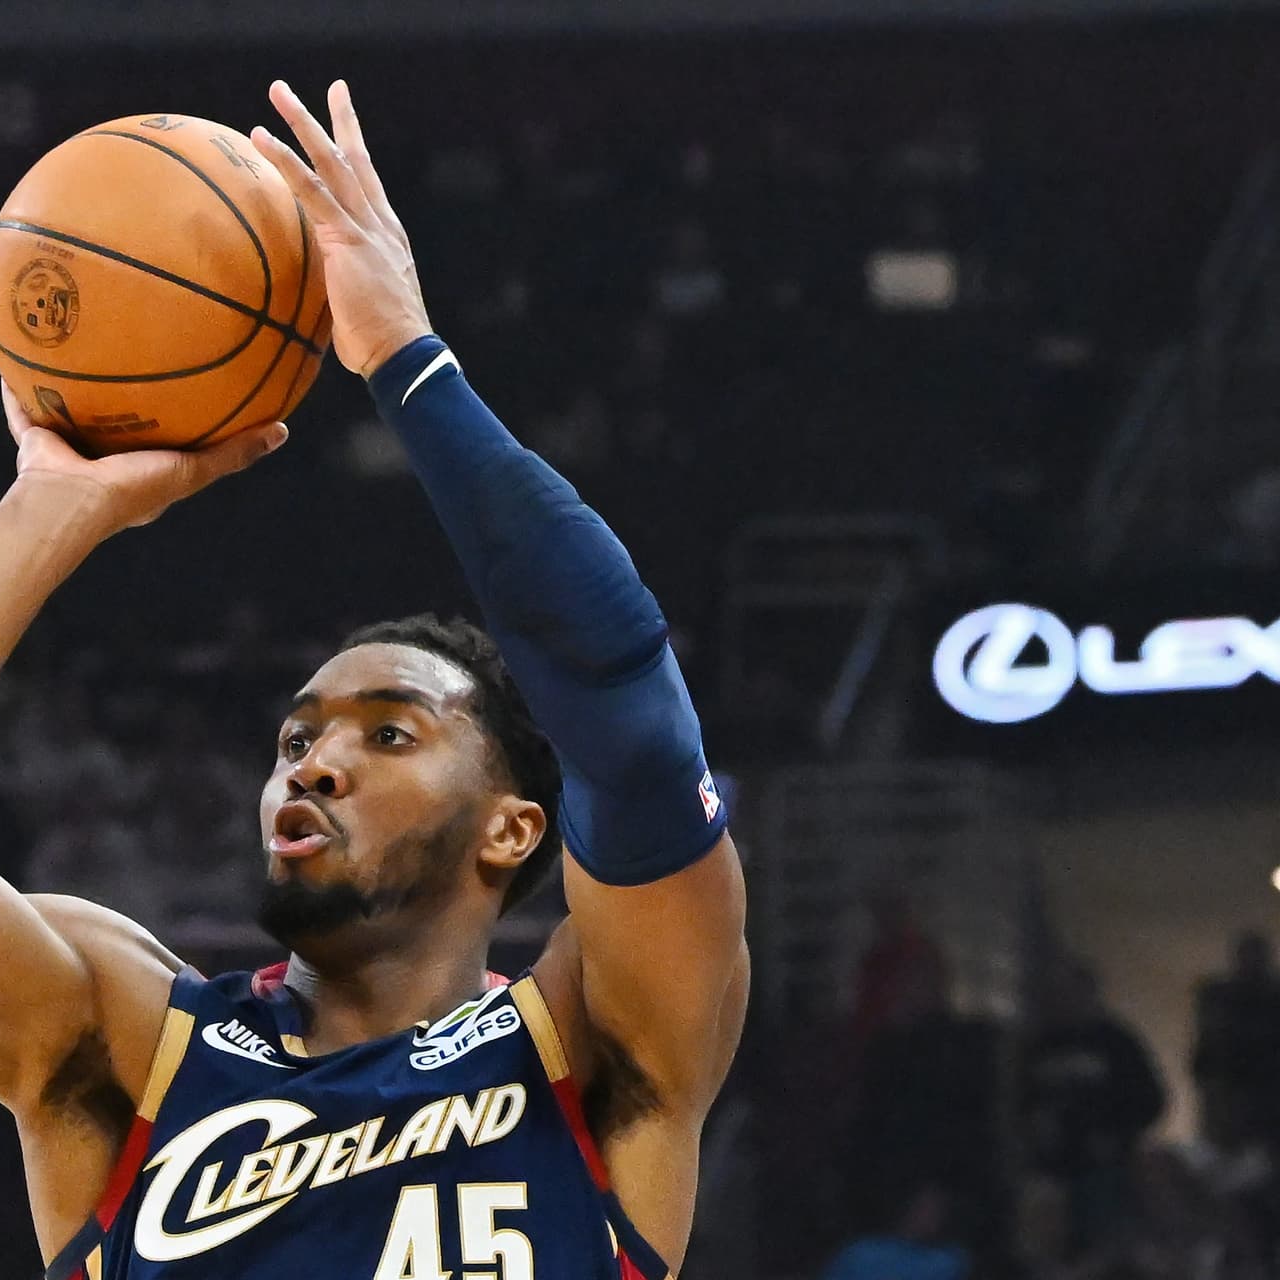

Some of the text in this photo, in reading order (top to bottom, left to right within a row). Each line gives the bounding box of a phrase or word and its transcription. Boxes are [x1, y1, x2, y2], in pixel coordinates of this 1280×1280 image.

[219, 1018, 277, 1057] NIKE
[415, 1011, 517, 1066] CLIFFS
[134, 1083, 527, 1261] CLEVELAND
